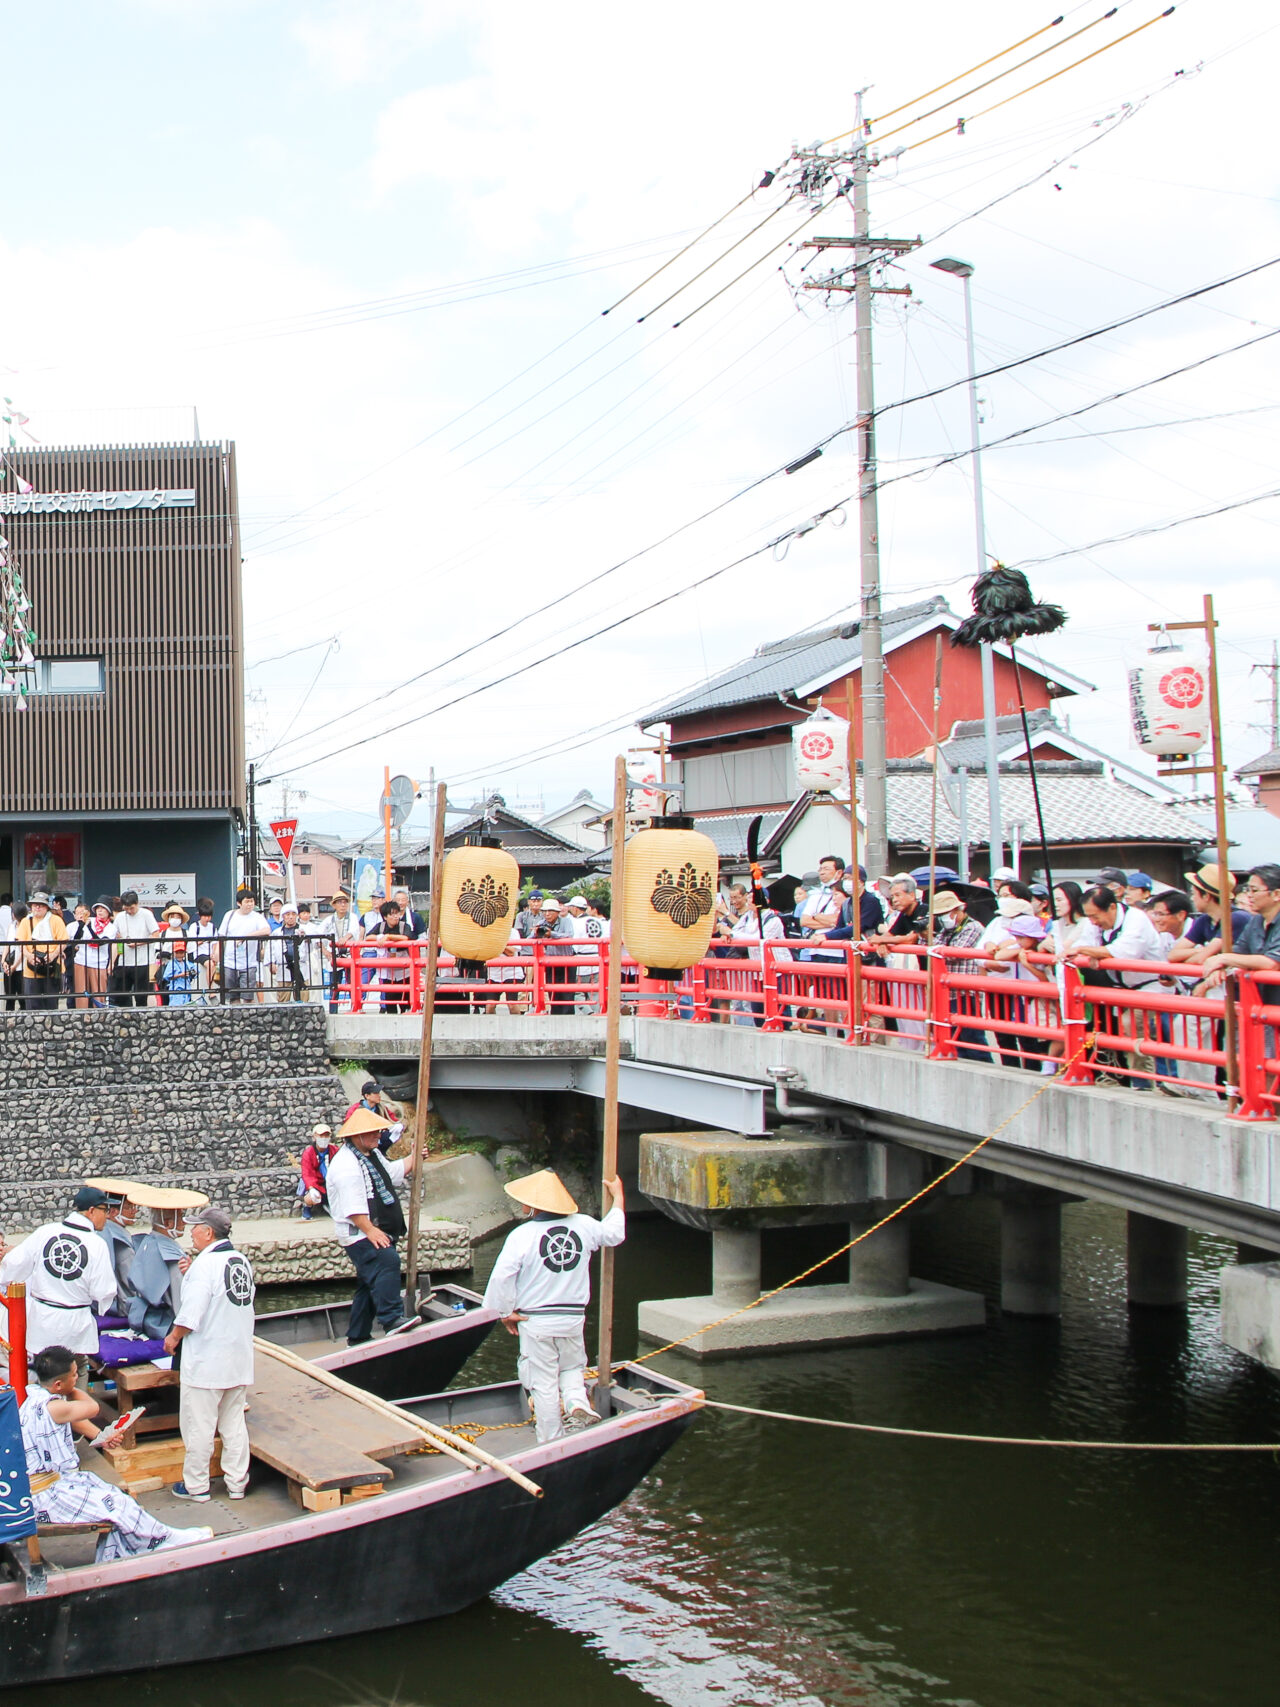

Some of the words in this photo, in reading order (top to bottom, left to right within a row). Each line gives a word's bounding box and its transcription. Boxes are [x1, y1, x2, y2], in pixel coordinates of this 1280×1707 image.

[275, 826, 295, 839] 止まれ
[154, 883, 187, 895] 祭人
